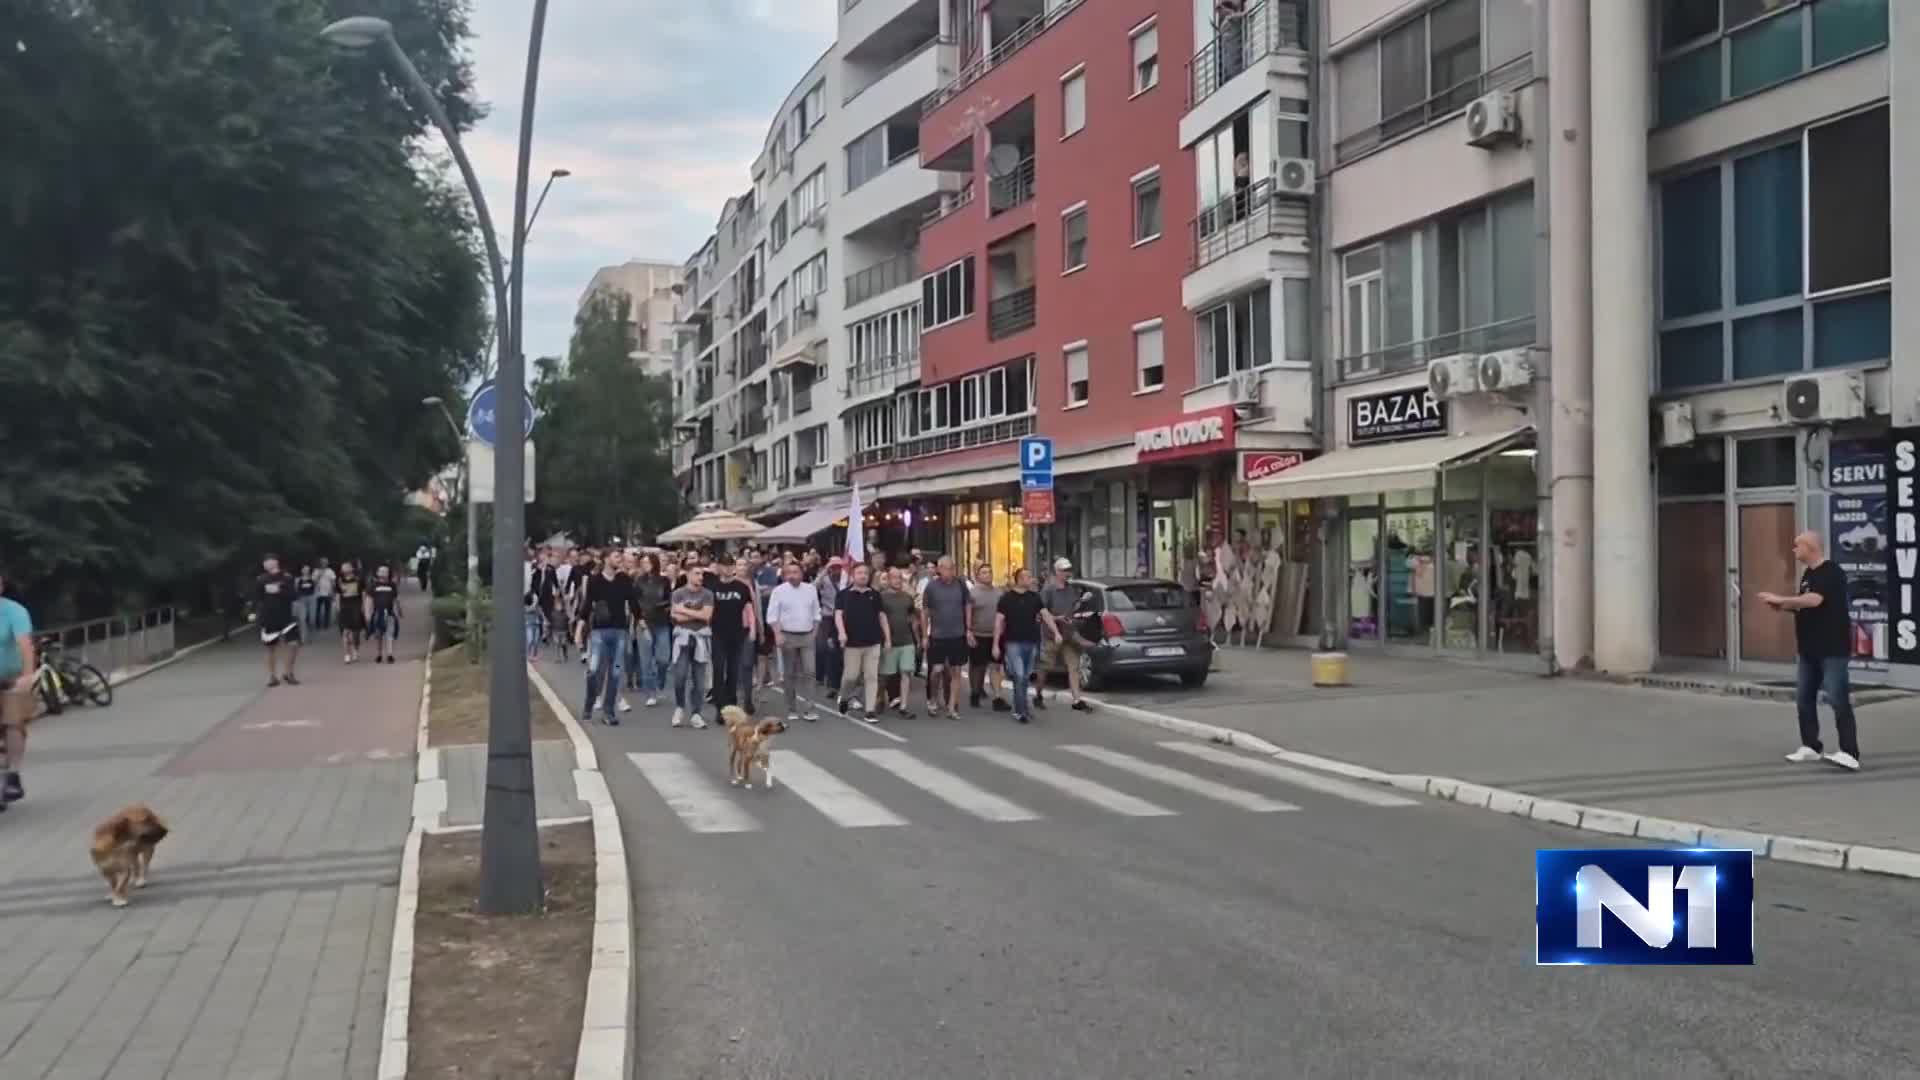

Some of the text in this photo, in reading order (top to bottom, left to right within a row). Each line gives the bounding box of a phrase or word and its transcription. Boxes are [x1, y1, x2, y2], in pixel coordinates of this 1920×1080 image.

[1357, 391, 1440, 427] BAZAR
[1028, 442, 1046, 468] P
[1895, 440, 1918, 651] SERVIS
